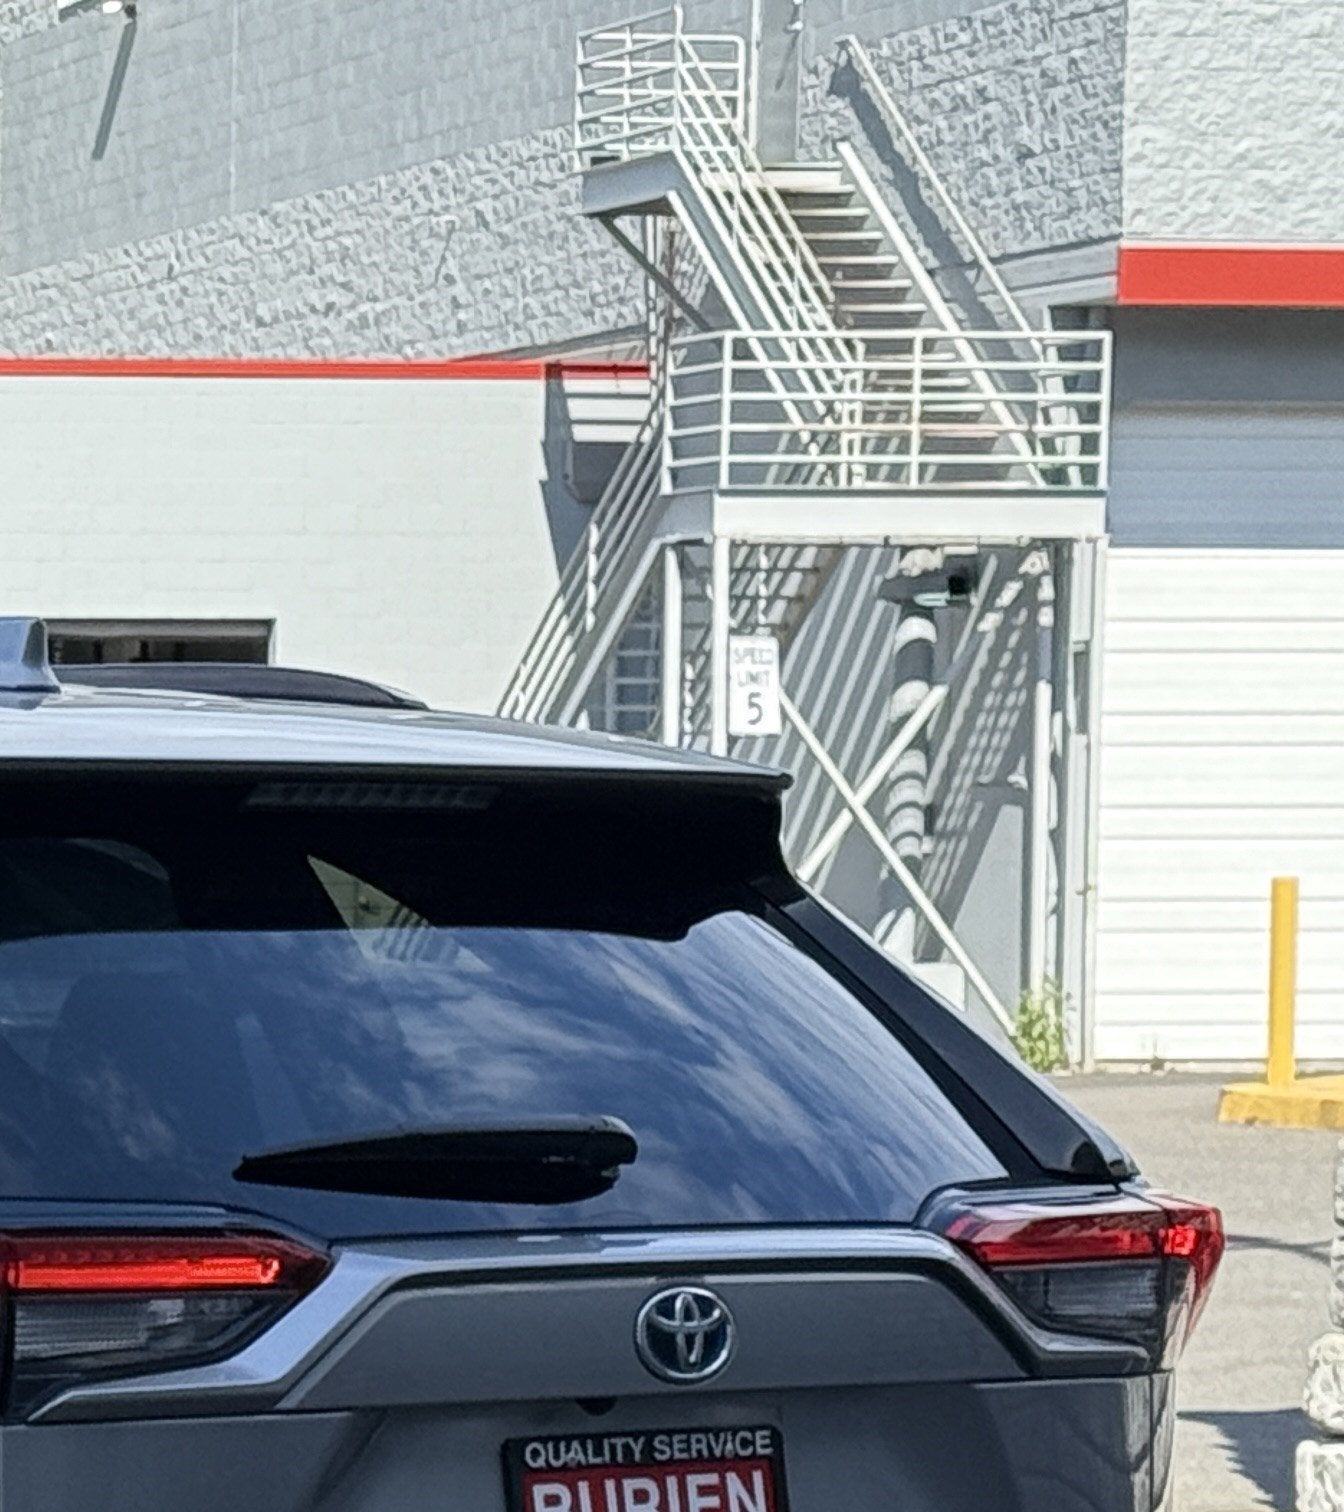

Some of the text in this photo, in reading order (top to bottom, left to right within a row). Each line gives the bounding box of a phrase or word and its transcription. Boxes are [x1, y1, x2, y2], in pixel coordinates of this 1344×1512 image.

[747, 692, 764, 726] 5
[525, 1430, 774, 1468] QUALITY SERVICE
